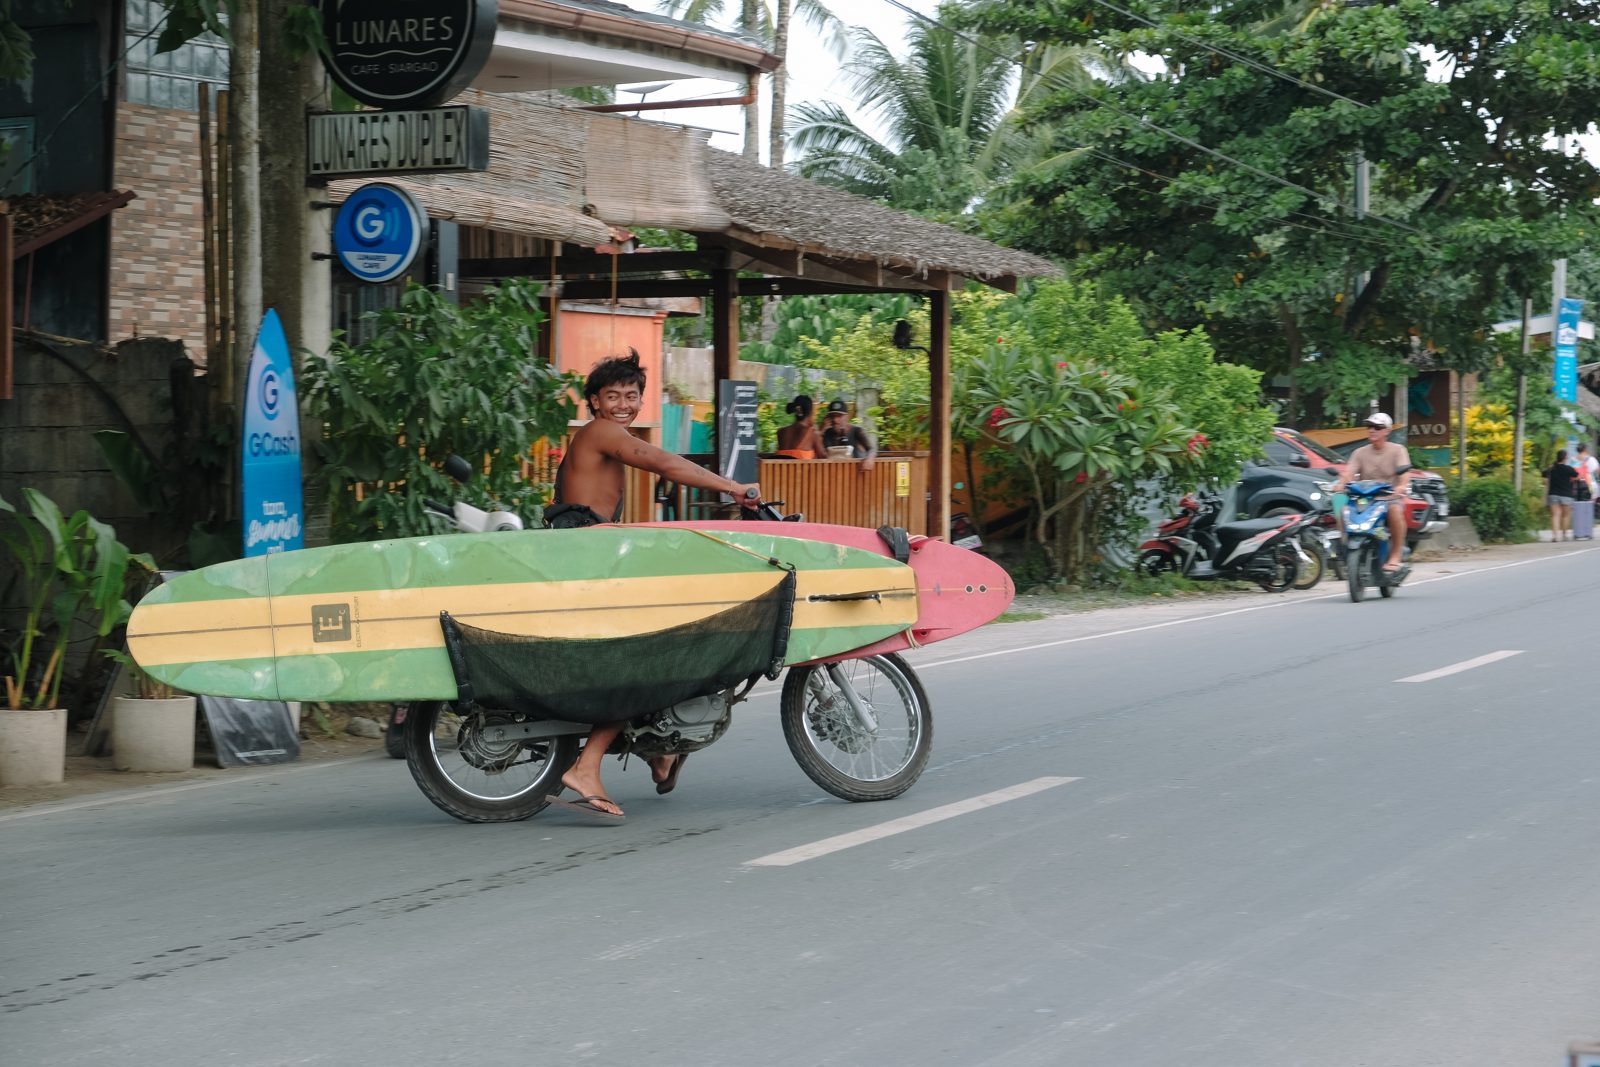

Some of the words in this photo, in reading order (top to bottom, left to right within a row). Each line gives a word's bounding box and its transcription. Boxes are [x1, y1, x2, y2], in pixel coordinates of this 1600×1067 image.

[336, 16, 453, 45] LUNARES
[352, 64, 380, 76] CAFE
[389, 61, 439, 74] SIARGAO
[311, 113, 391, 172] LUNARES
[397, 110, 466, 169] DUPLEX
[356, 206, 385, 239] G
[249, 431, 298, 458] GCash
